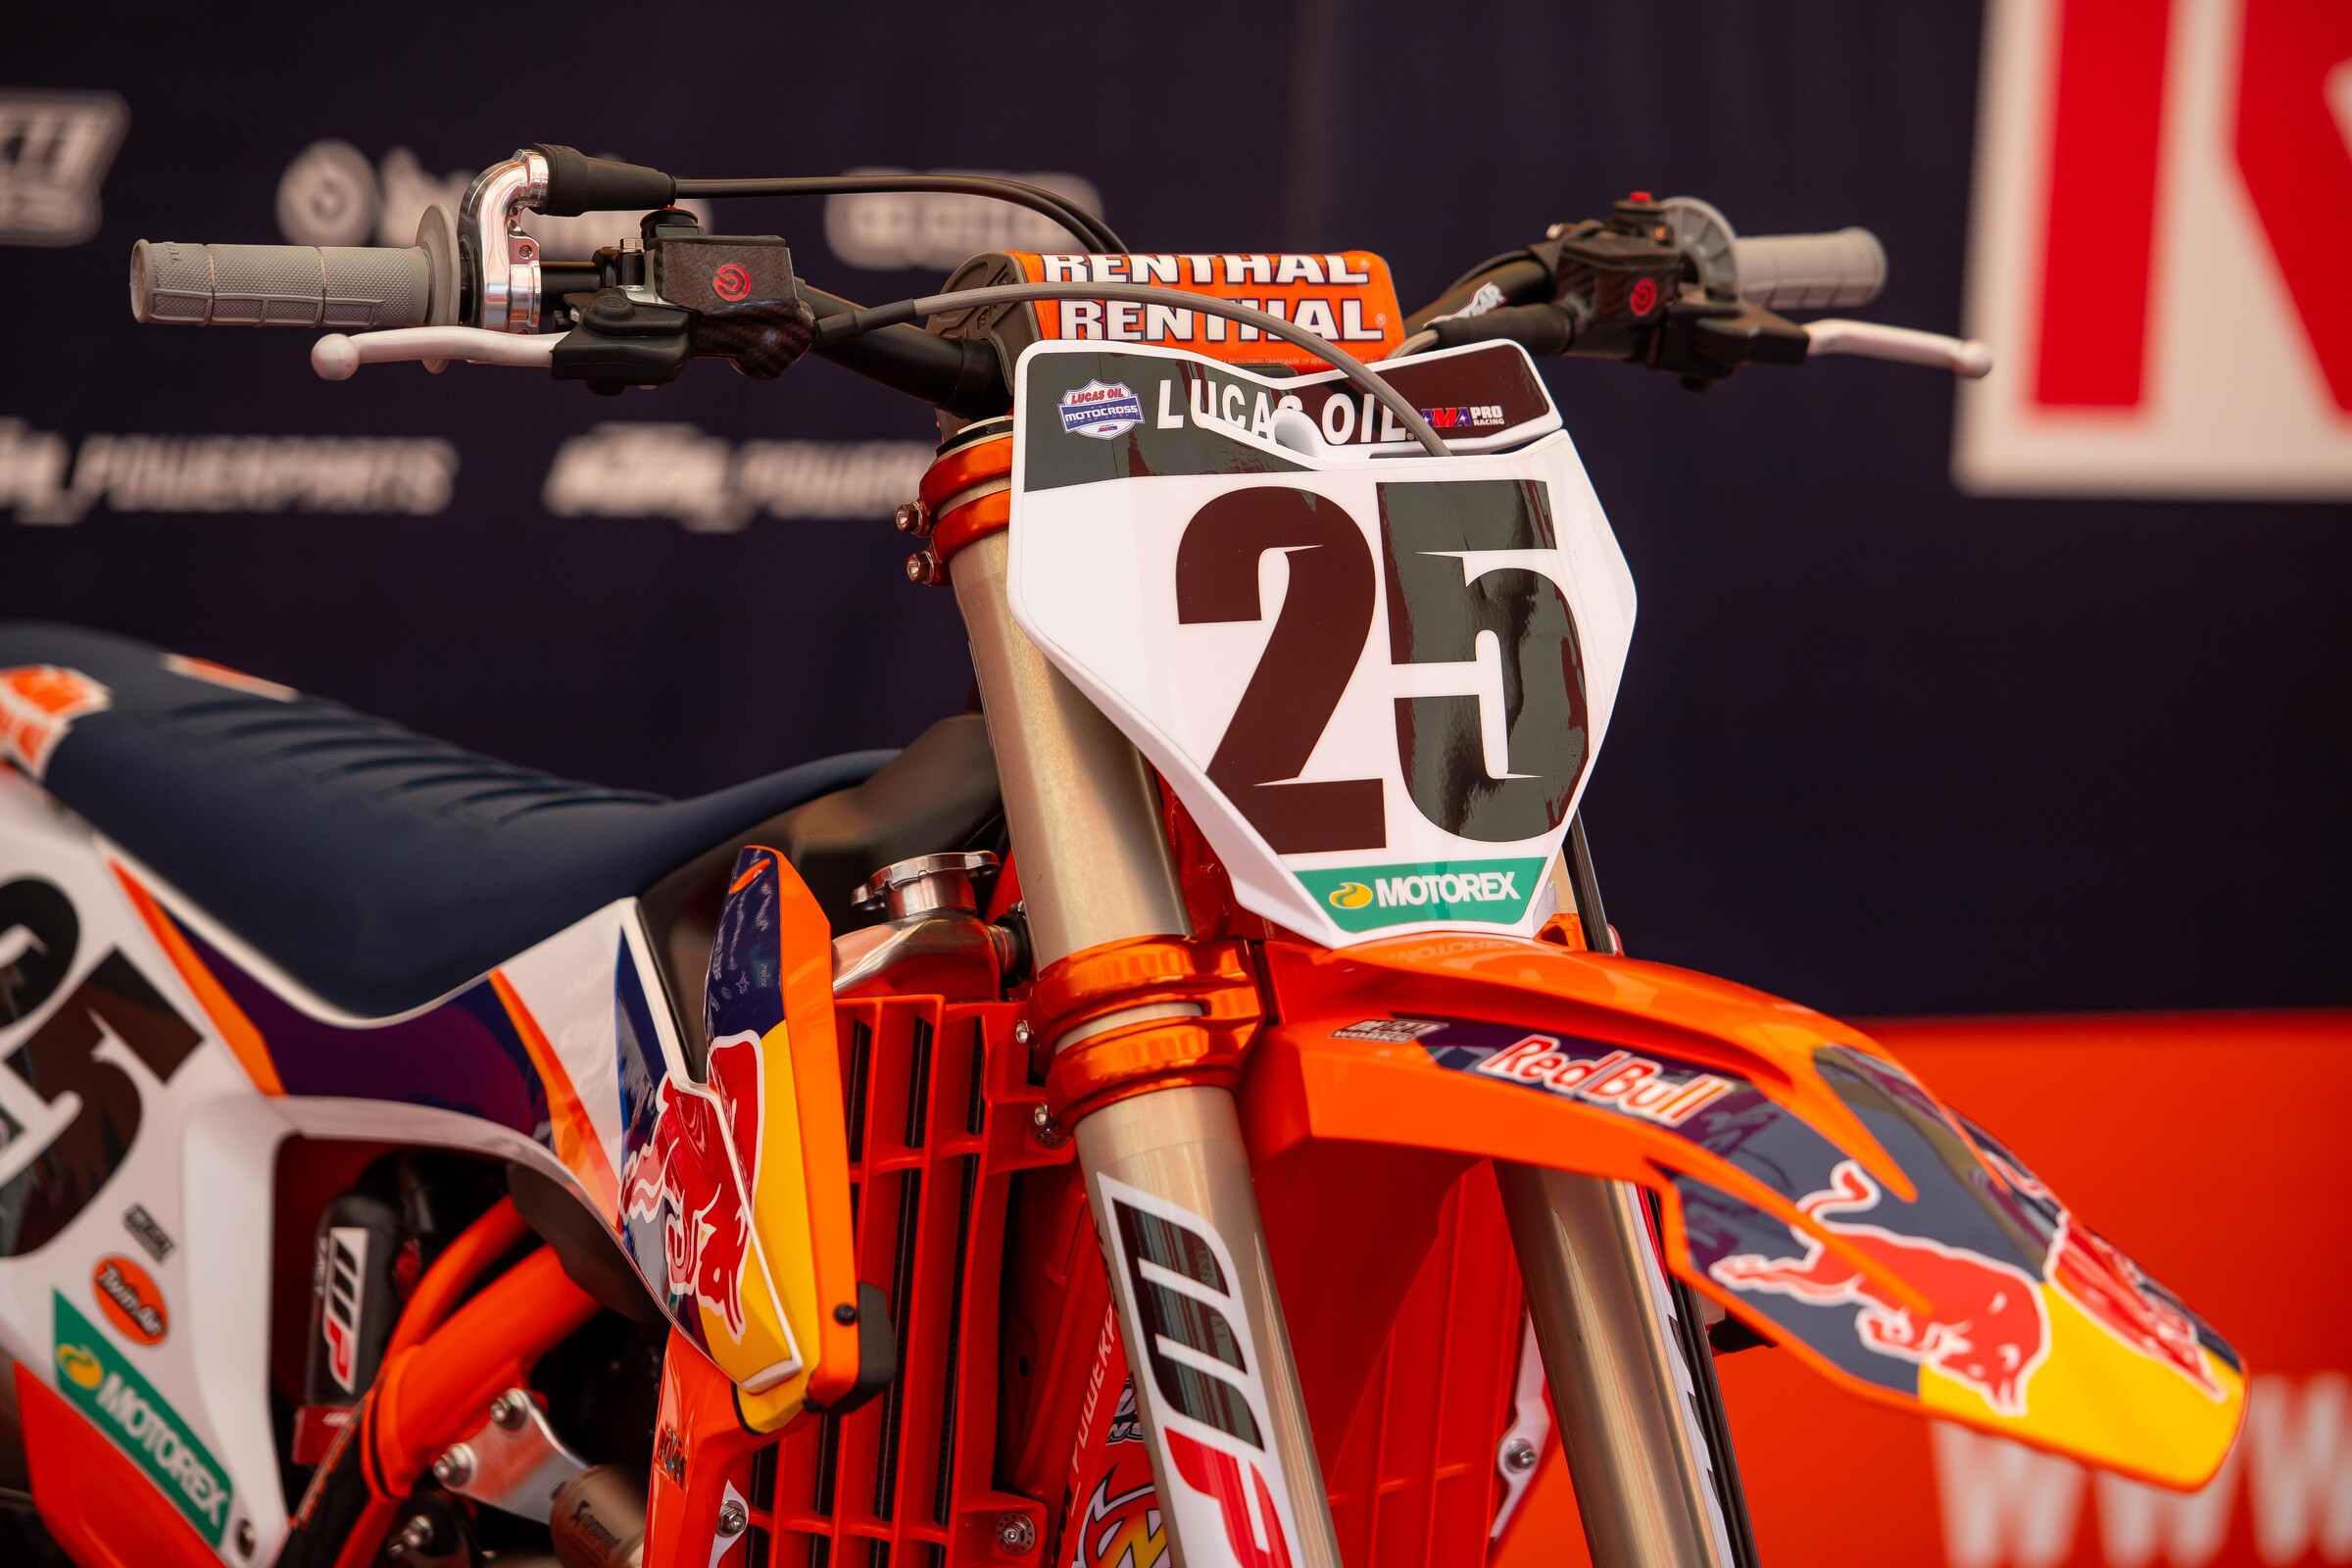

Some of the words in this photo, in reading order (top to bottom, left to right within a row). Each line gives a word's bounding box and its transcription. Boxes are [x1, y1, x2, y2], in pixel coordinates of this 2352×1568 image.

[1043, 254, 1369, 284] RENTHAL
[1071, 390, 1105, 405] LUCAS
[1106, 388, 1124, 399] OIL
[1065, 405, 1139, 422] MOTOCROSS
[1322, 392, 1406, 445] OIL
[1421, 407, 1472, 428] AMA
[1470, 405, 1503, 419] PRO
[1473, 417, 1505, 426] RACING
[1175, 478, 1590, 857] 25
[1374, 871, 1522, 908] MOTOREX
[95, 1371, 227, 1529] MOTOREX
